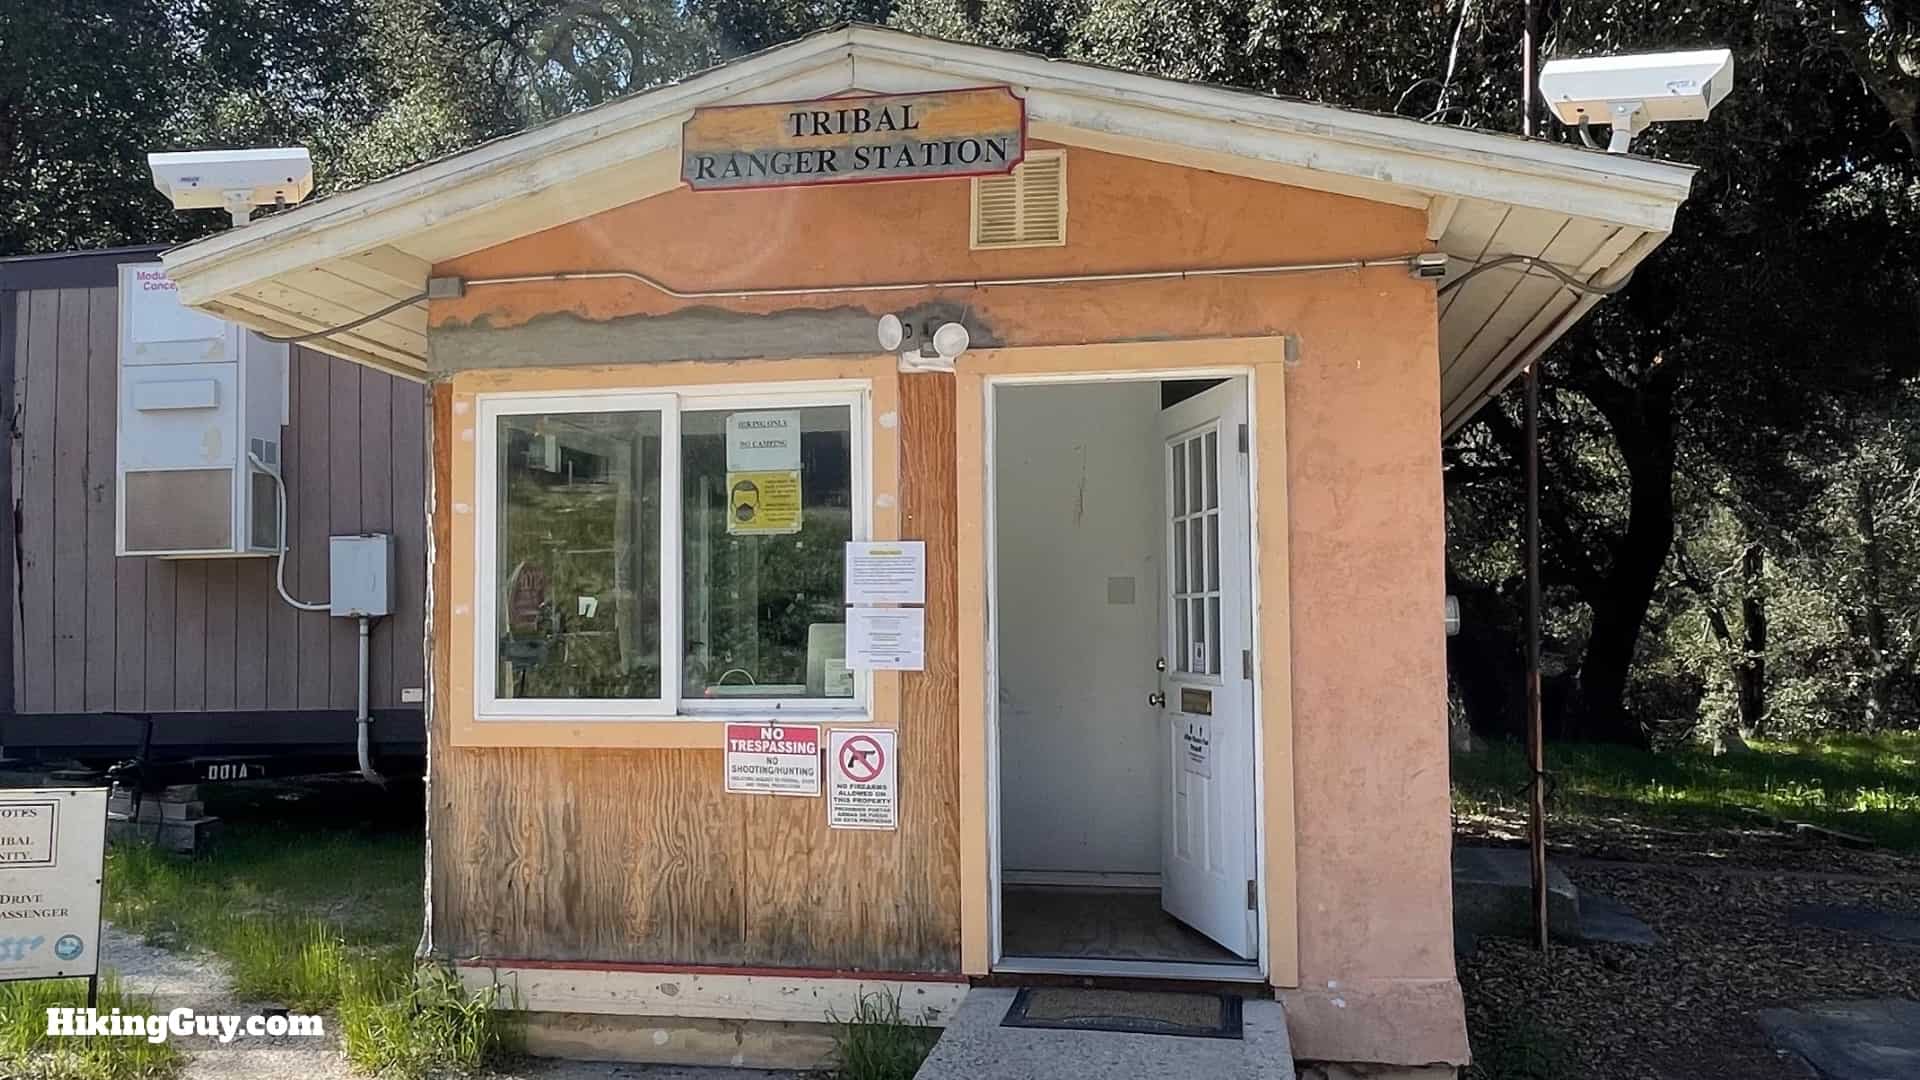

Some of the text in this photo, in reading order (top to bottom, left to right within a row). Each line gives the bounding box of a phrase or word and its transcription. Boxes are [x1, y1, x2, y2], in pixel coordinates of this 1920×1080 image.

[789, 105, 920, 137] TRIBAL
[696, 137, 1008, 180] RANGER STATION
[143, 281, 178, 291] Conce
[760, 727, 785, 740] NO
[729, 739, 817, 754] TRESPASSING
[766, 757, 779, 765] NO
[731, 764, 815, 777] SHOOTING/HUNTING
[0, 808, 37, 818] OTES
